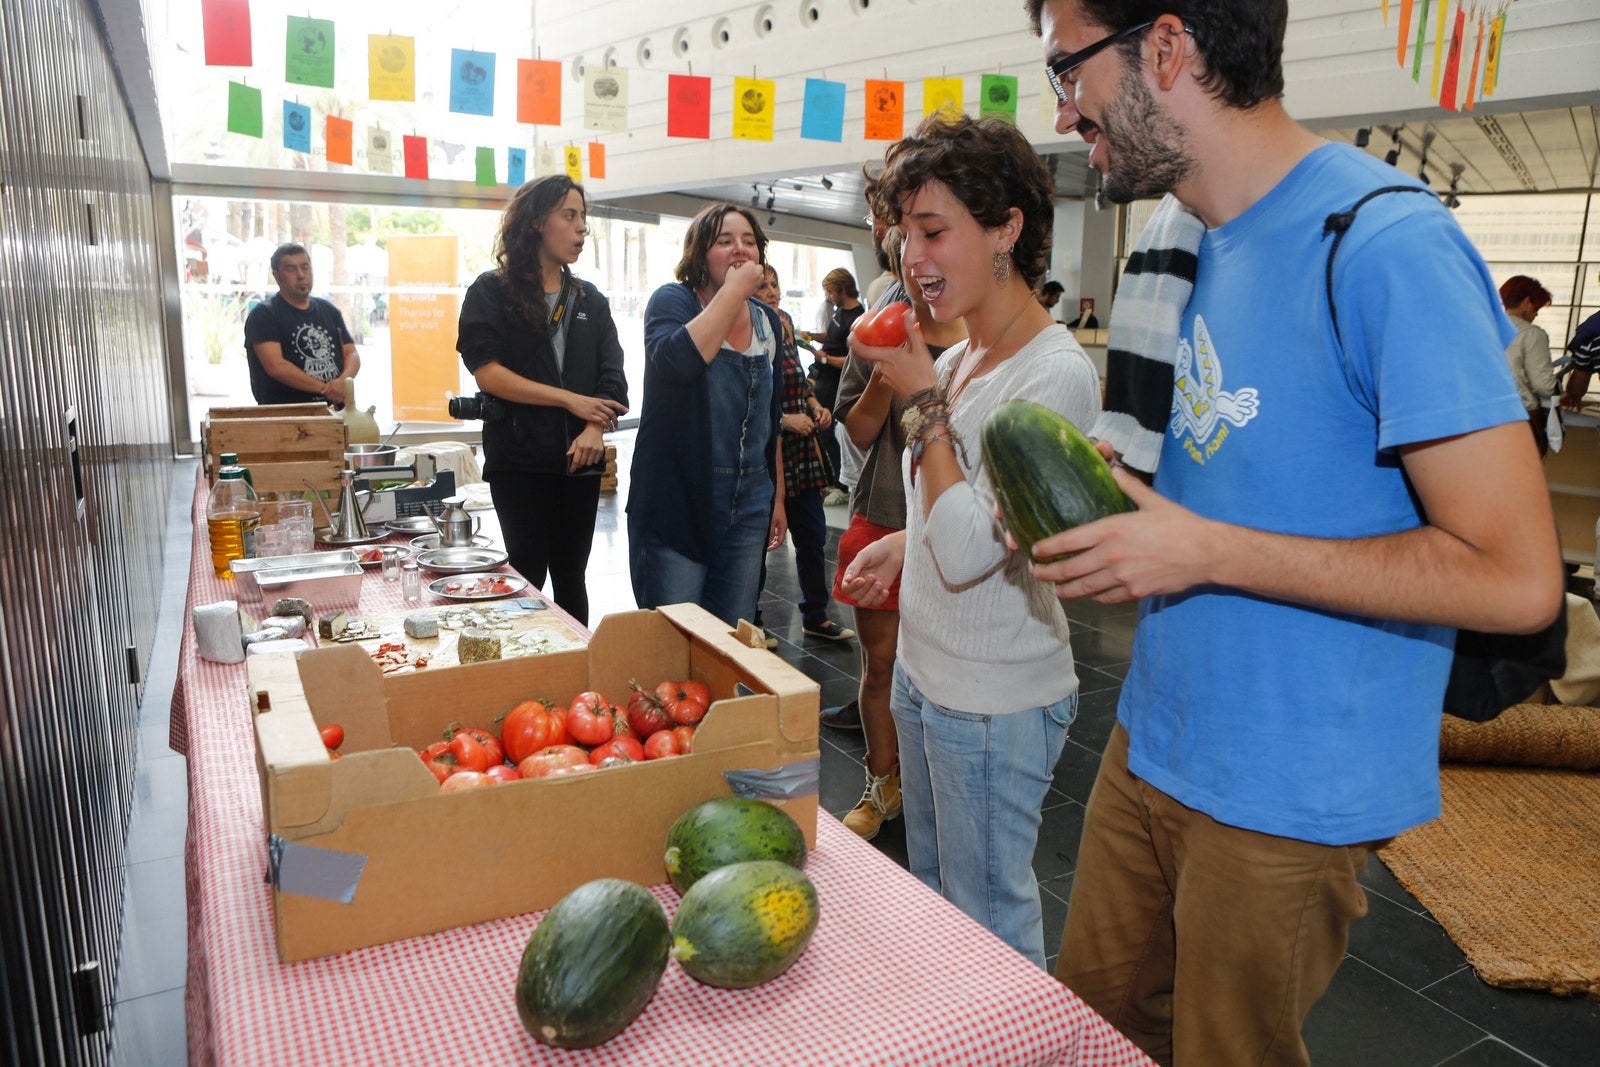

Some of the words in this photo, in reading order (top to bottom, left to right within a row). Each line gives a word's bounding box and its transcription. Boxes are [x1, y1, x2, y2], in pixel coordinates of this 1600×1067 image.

[399, 307, 432, 318] Thanks
[432, 307, 445, 318] for
[400, 321, 417, 331] your
[419, 319, 439, 329] visit
